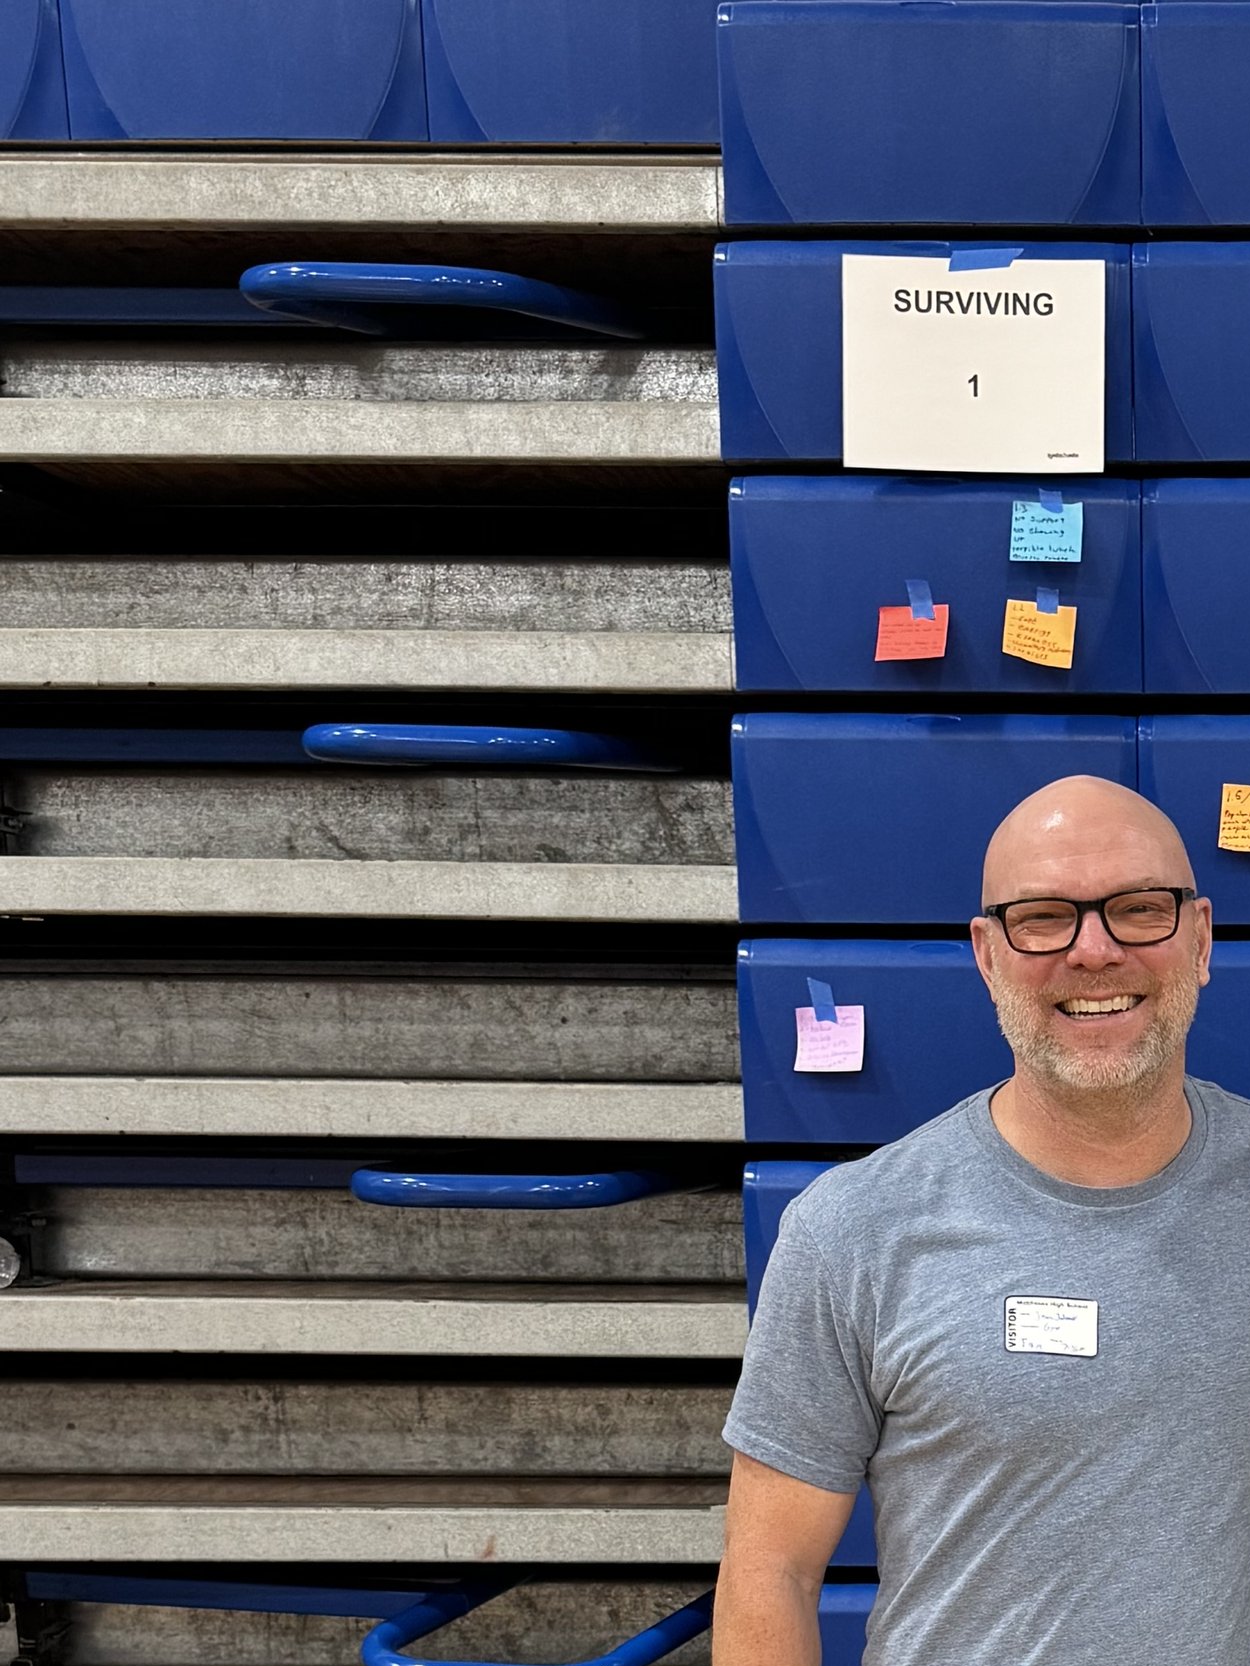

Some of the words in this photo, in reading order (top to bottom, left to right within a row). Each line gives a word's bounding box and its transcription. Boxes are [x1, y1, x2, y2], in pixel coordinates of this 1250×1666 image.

[894, 289, 1054, 316] SURVIVING
[968, 374, 978, 397] 1
[1008, 1308, 1017, 1348] VISITOR
